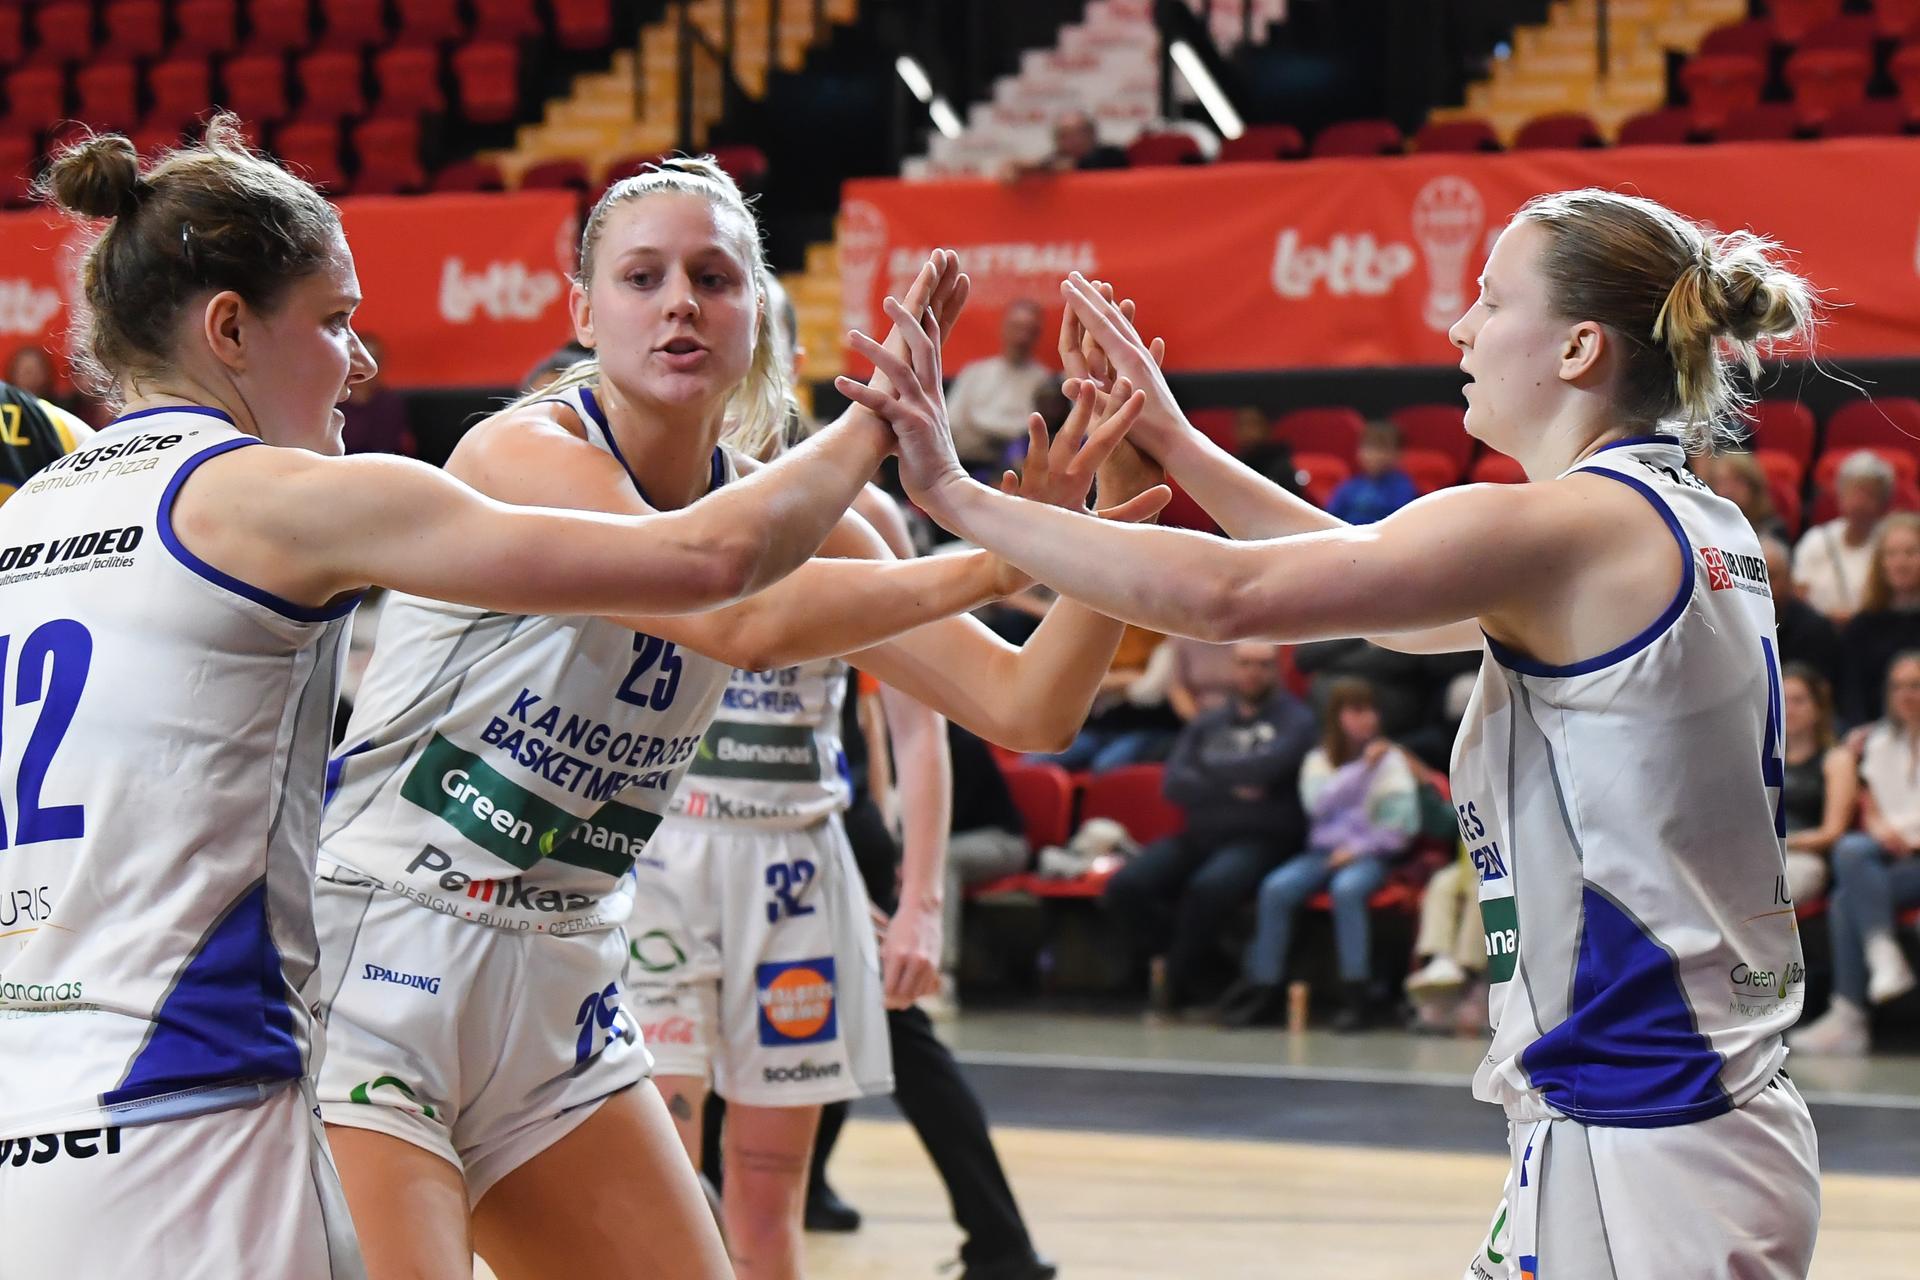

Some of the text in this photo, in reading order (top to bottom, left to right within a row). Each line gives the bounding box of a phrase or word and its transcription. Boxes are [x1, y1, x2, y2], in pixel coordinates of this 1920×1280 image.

[888, 242, 1098, 276] BAETBALL
[102, 456, 160, 480] Pizza
[45, 526, 144, 564] VIDEO
[91, 556, 135, 572] facilities
[615, 631, 683, 712] 25
[508, 687, 700, 769] KANGOEROES
[441, 768, 534, 846] Green
[392, 879, 459, 917] DESIGN
[477, 912, 531, 932] BUILD
[766, 859, 816, 924] 32
[0, 974, 83, 1002] ananas
[362, 963, 441, 995] SPALDING
[1730, 962, 1777, 988] Green
